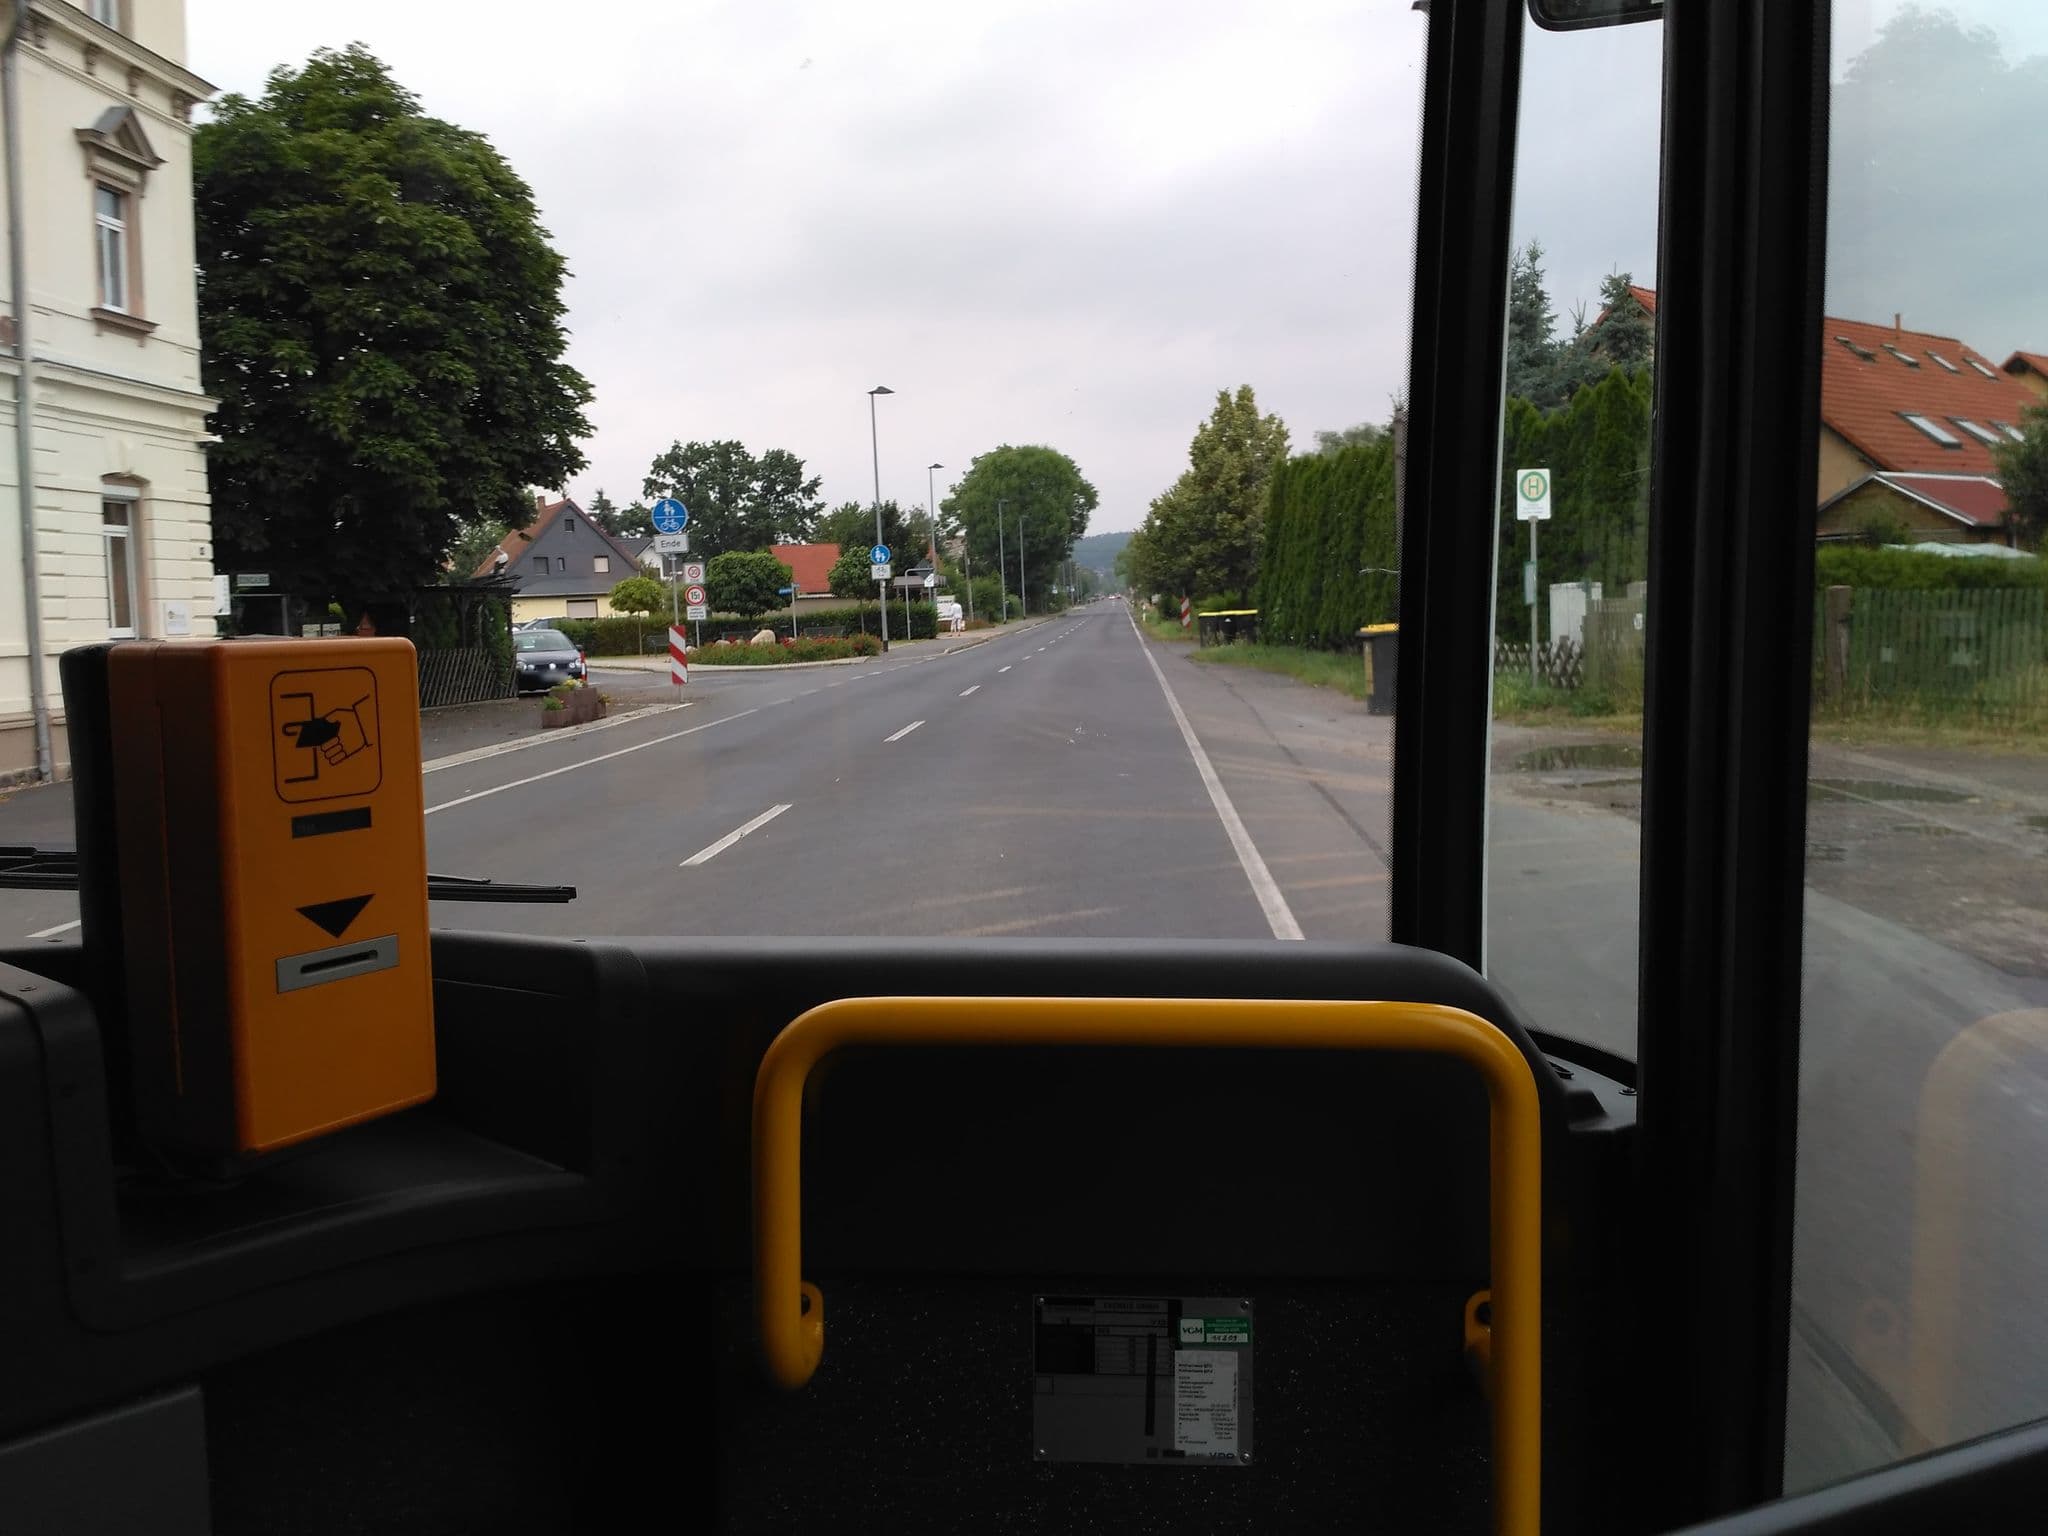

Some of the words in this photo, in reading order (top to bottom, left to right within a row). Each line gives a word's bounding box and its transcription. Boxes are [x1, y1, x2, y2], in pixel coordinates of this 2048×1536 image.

[1528, 478, 1539, 496] H
[660, 539, 681, 548] Ende
[1182, 1326, 1203, 1335] VGM
